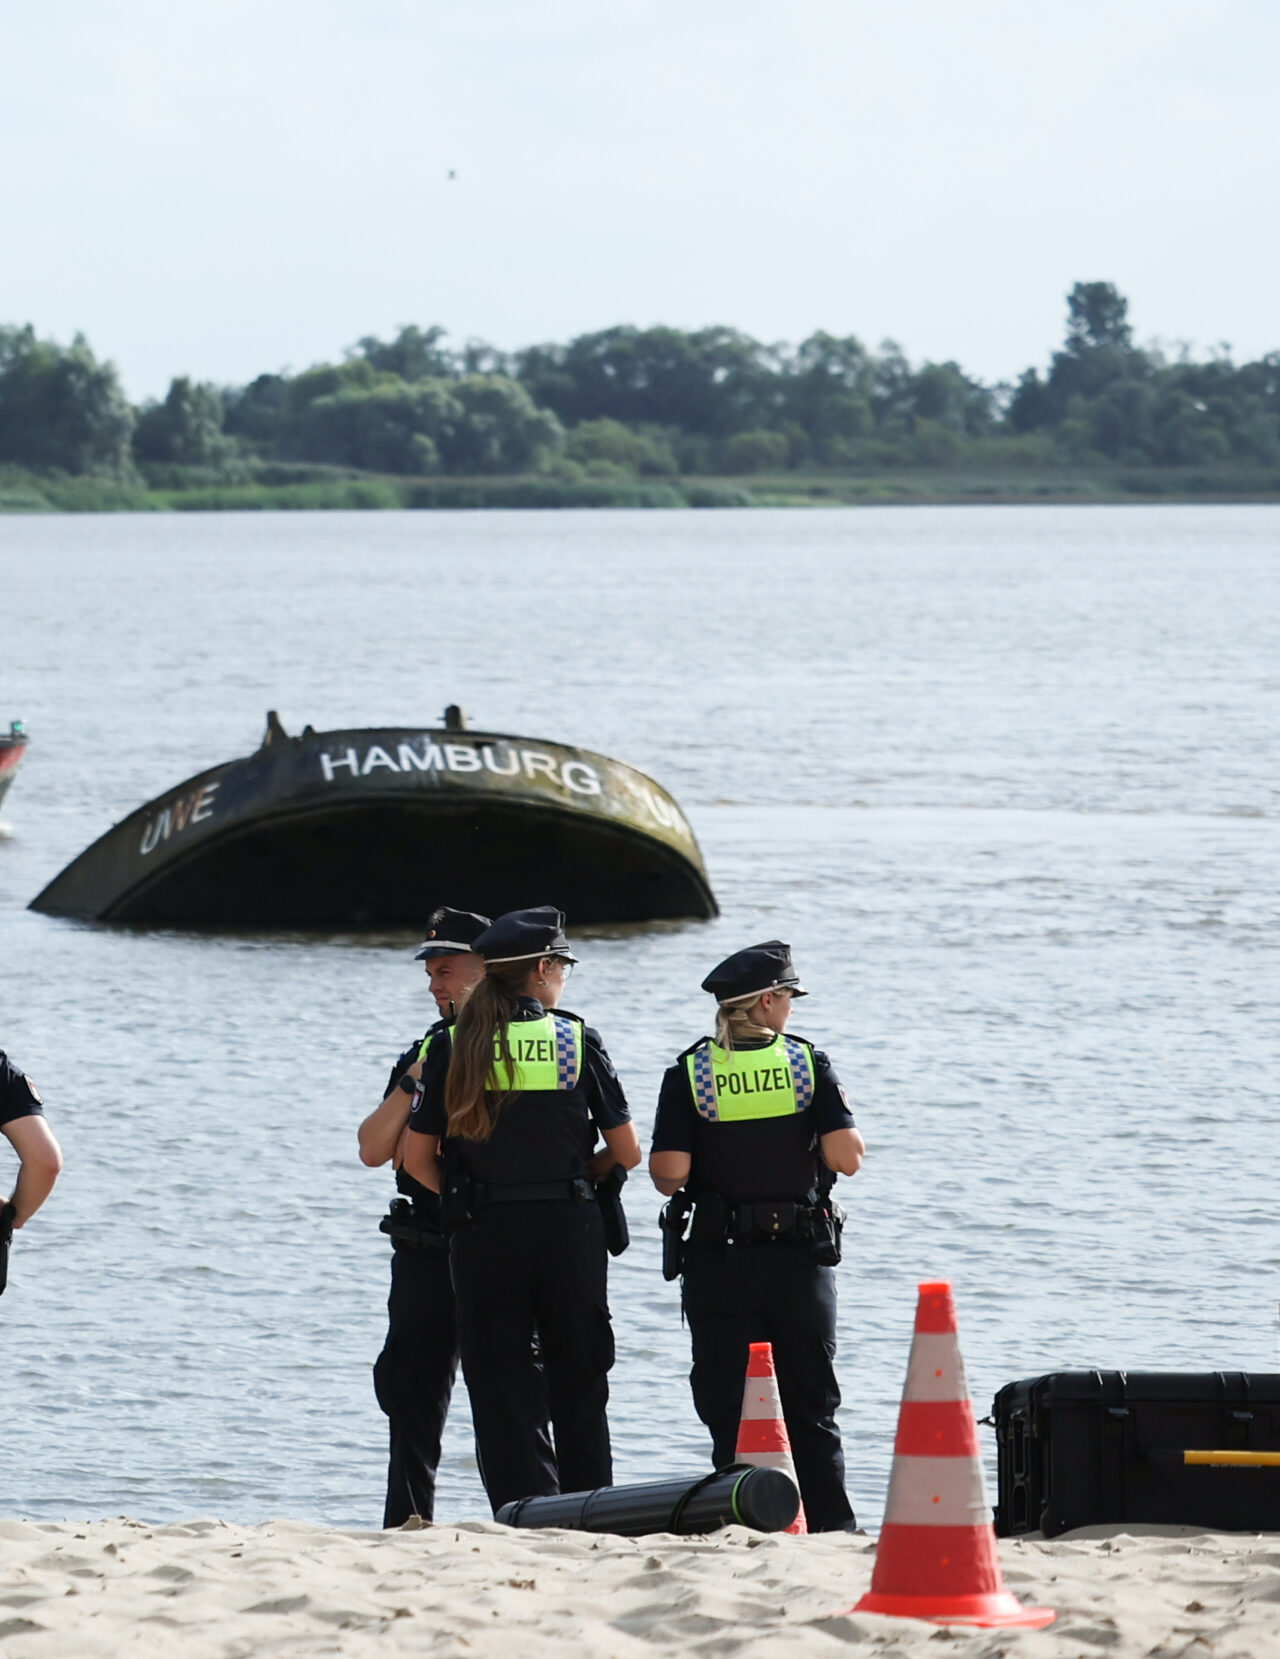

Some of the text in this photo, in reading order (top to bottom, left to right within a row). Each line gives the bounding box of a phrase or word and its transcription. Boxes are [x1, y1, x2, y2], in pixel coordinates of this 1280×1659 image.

[320, 743, 602, 796] HAMBURG
[140, 782, 220, 855] UWE
[492, 1039, 554, 1062] OLIZEI
[715, 1067, 791, 1097] POLIZEI
